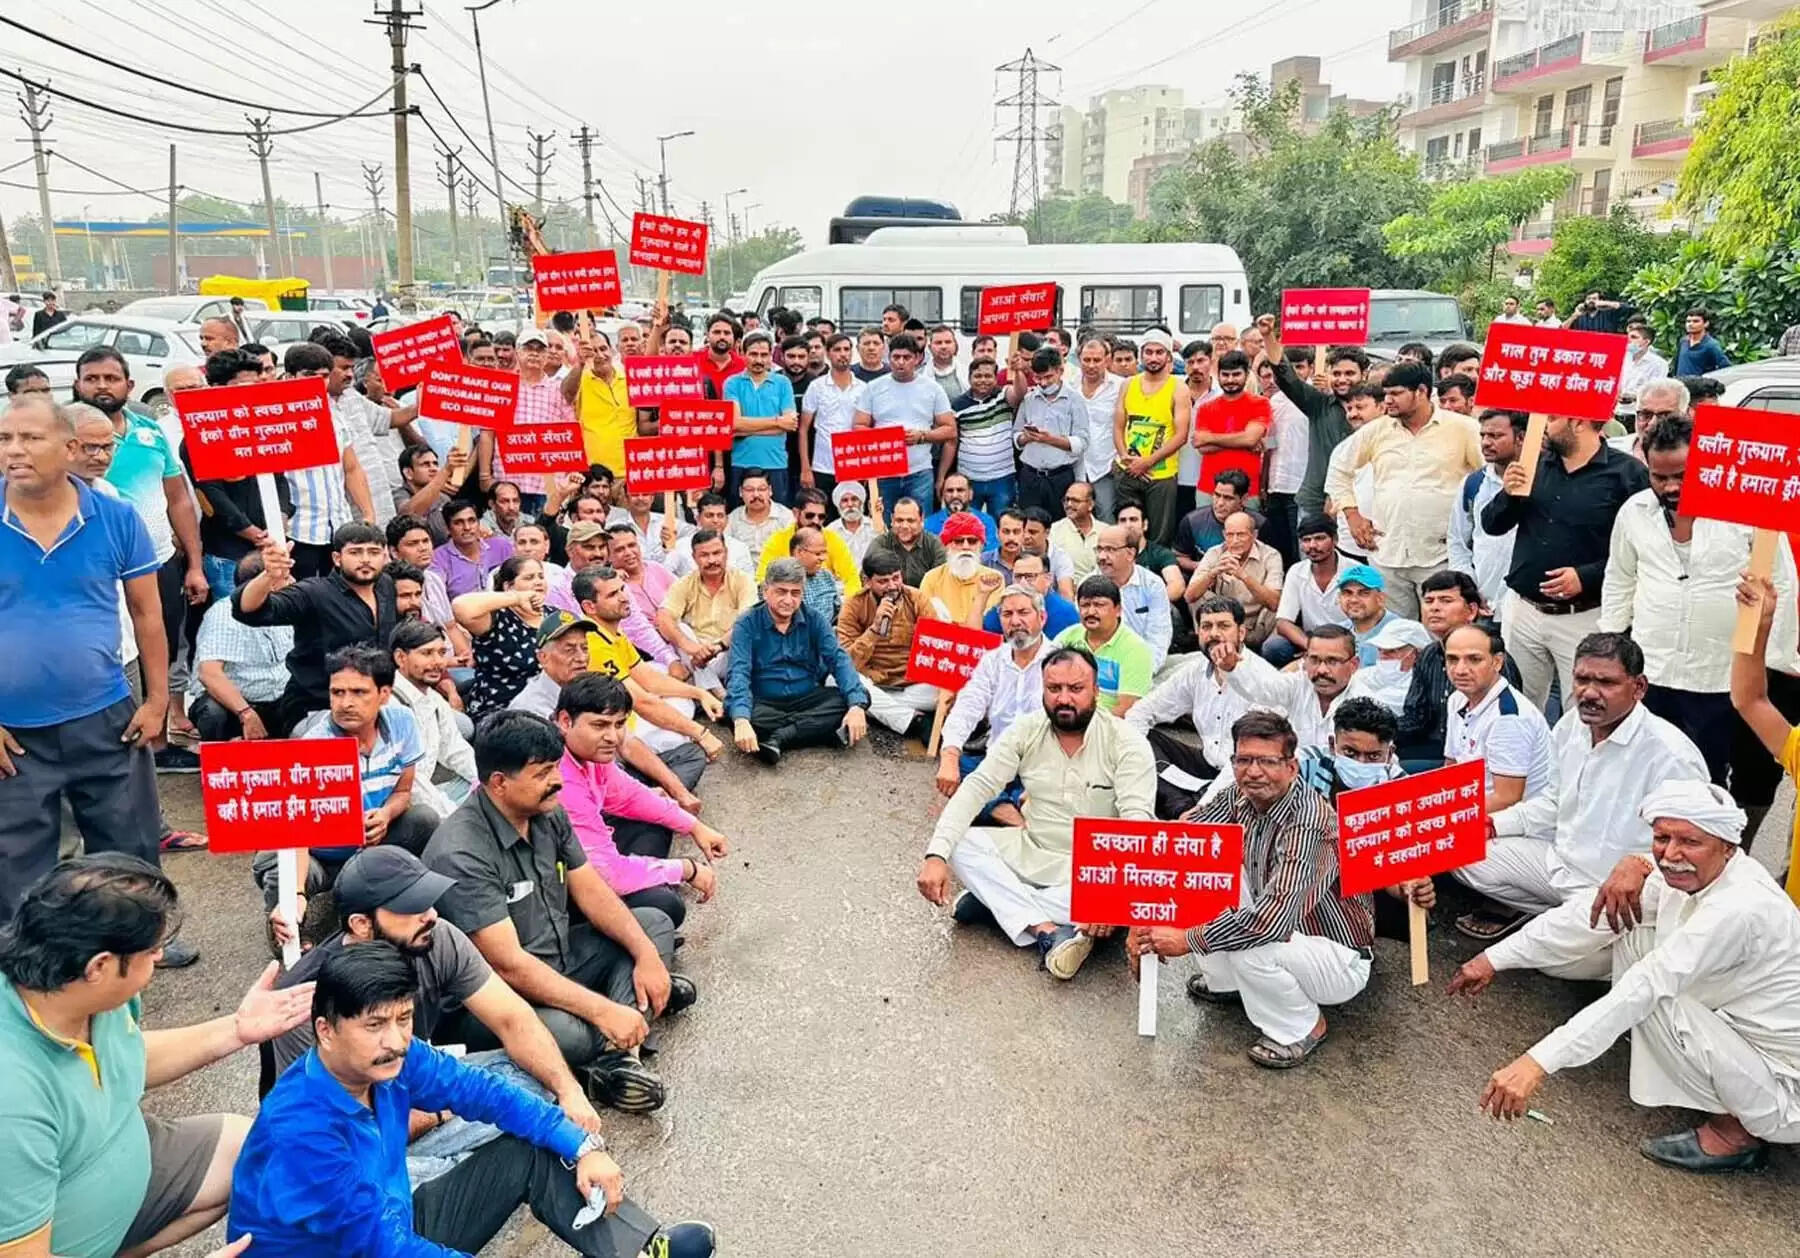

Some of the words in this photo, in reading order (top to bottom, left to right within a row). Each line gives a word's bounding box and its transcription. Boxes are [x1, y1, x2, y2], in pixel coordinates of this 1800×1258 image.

[1501, 343, 1526, 358] माल
[1530, 346, 1549, 366] तुम
[1484, 363, 1507, 380] और
[233, 404, 248, 418] को
[287, 397, 323, 412] बनाओ
[301, 417, 317, 430] को
[234, 446, 252, 457] मत
[257, 440, 292, 456] बनाओ
[504, 453, 536, 464] अपना
[1727, 464, 1737, 491] है
[1740, 473, 1778, 495] हमारा
[240, 797, 248, 821] है
[252, 801, 283, 820] हमारा
[1395, 800, 1412, 815] का
[1417, 788, 1456, 810] उपयोग
[1460, 779, 1480, 799] करें
[1395, 821, 1412, 838] को
[1416, 816, 1446, 833] स्वच्छ
[1451, 803, 1480, 823] बनाने
[1091, 832, 1147, 853] स्वच्छता
[1152, 831, 1168, 856] ही
[1173, 832, 1205, 856] सेवा
[1210, 832, 1223, 858] है
[1389, 841, 1432, 864] सहयोग
[1436, 833, 1455, 850] करें
[1077, 861, 1117, 884] आओ
[1123, 863, 1178, 889] मिलकर
[1184, 871, 1233, 890] आवाज
[1129, 897, 1177, 921] उठाओ
